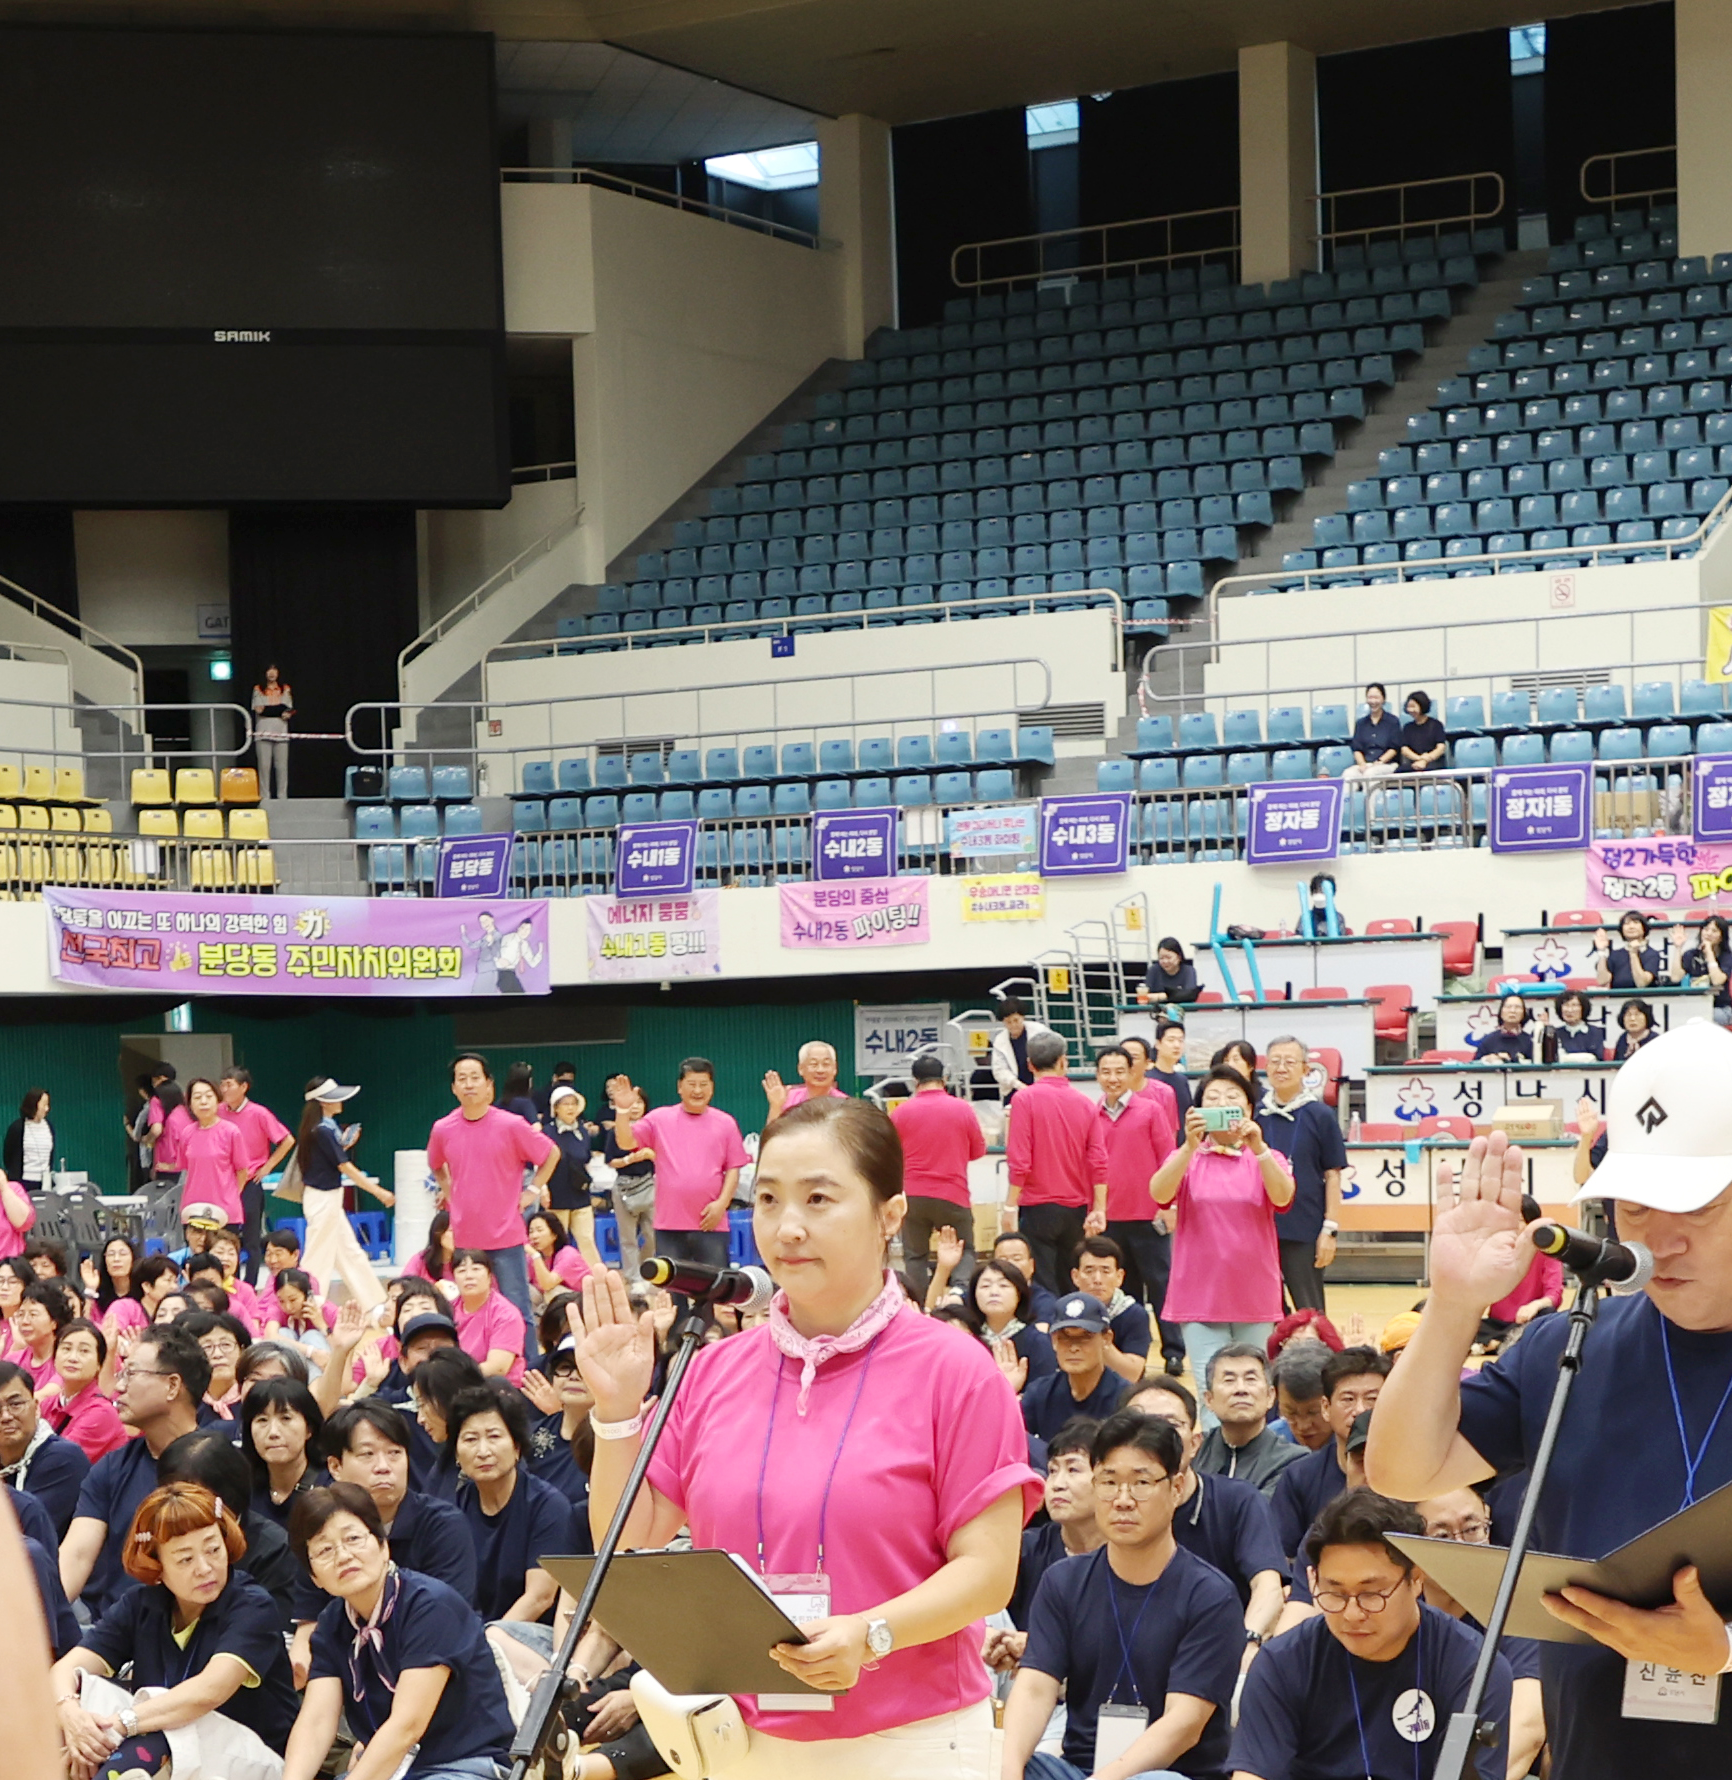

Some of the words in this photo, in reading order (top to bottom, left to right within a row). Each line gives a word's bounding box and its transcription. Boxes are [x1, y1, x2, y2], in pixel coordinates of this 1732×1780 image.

[213, 330, 271, 342] SAMIK
[1505, 794, 1574, 820] 정자1동
[1264, 808, 1321, 832] 정자동
[1051, 822, 1116, 846] 수내3동
[626, 847, 681, 869] 수내1동
[824, 836, 884, 859] 수내2동
[449, 857, 495, 879] 분당동
[813, 889, 856, 908] 분당의
[860, 887, 890, 906] 중심
[155, 911, 173, 932] 또
[175, 913, 221, 933] 하나의
[224, 912, 270, 934] 강력한
[273, 913, 288, 935] 힘
[607, 903, 653, 925] 에너지
[792, 920, 849, 942] 수내2동
[852, 902, 922, 940] 파이팅!!
[60, 927, 162, 972] 전국최고
[197, 942, 278, 977] 분당동
[284, 943, 463, 980] 주민자치위원회
[600, 931, 668, 960] 수내1동
[864, 1027, 938, 1055] 수내2동
